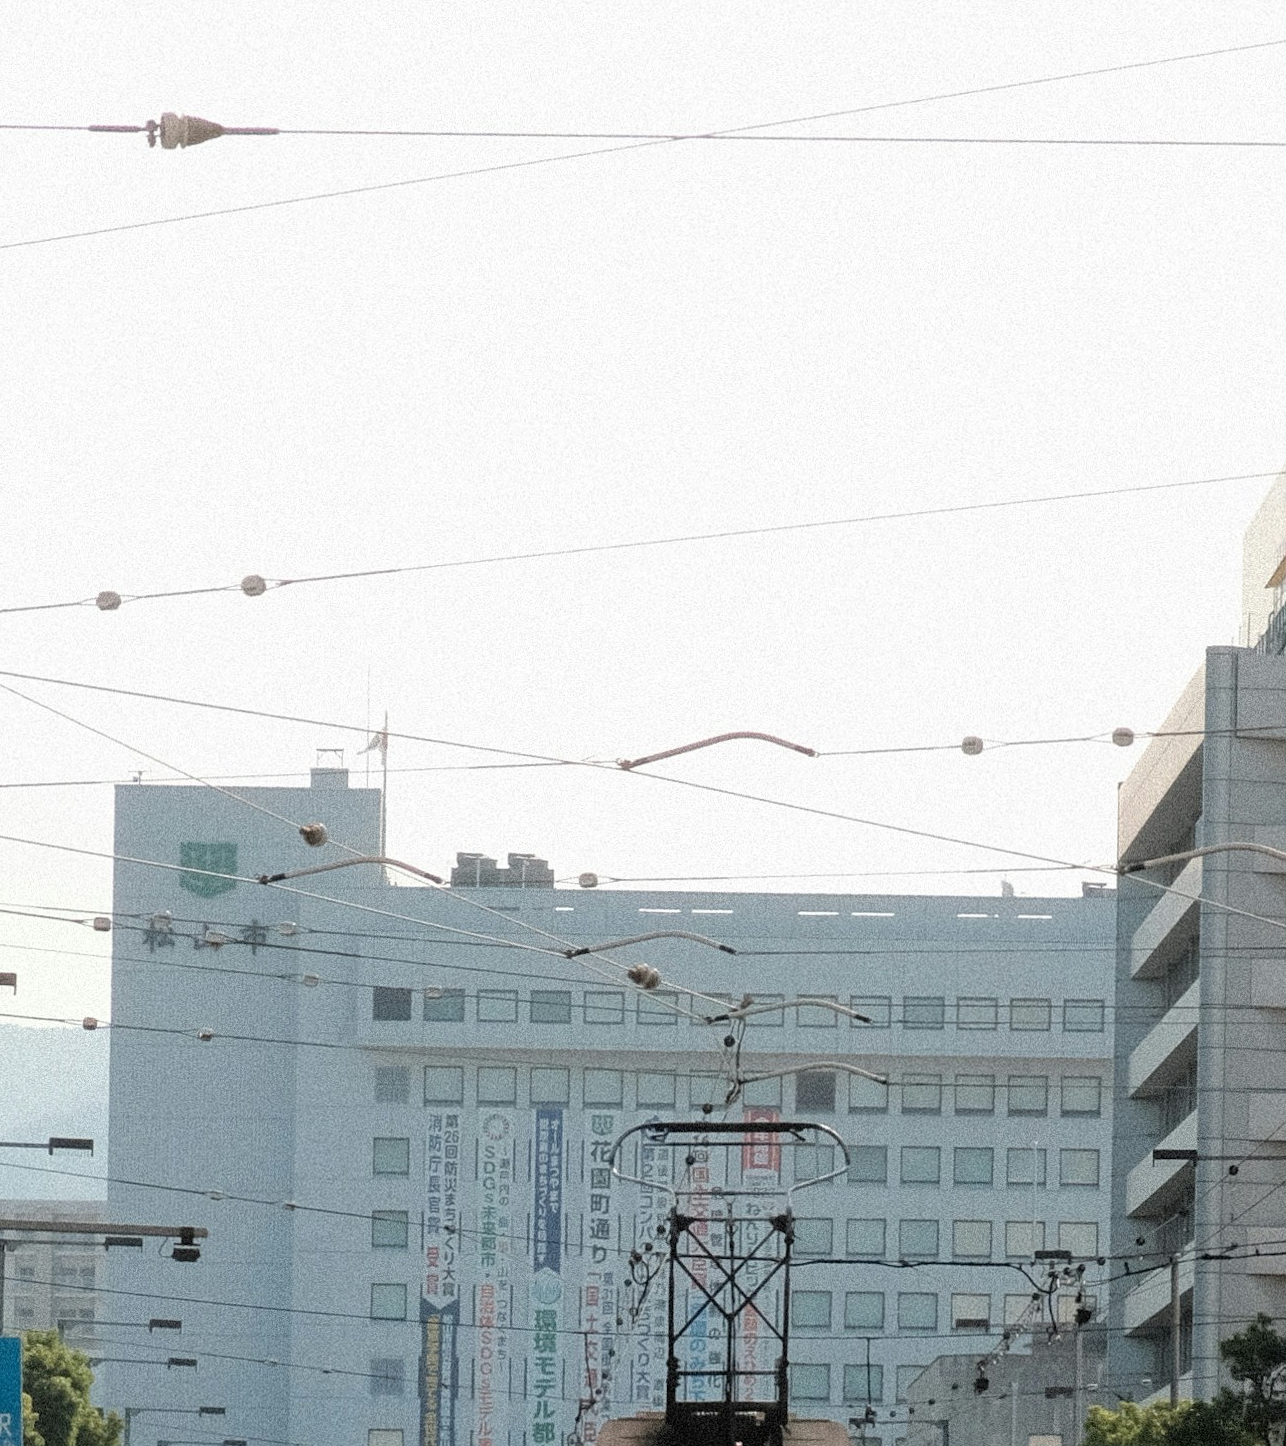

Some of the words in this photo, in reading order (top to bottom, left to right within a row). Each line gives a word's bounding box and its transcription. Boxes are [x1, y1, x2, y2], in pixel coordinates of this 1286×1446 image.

[441, 1113, 460, 1297] 第26回防災まちくり大賞
